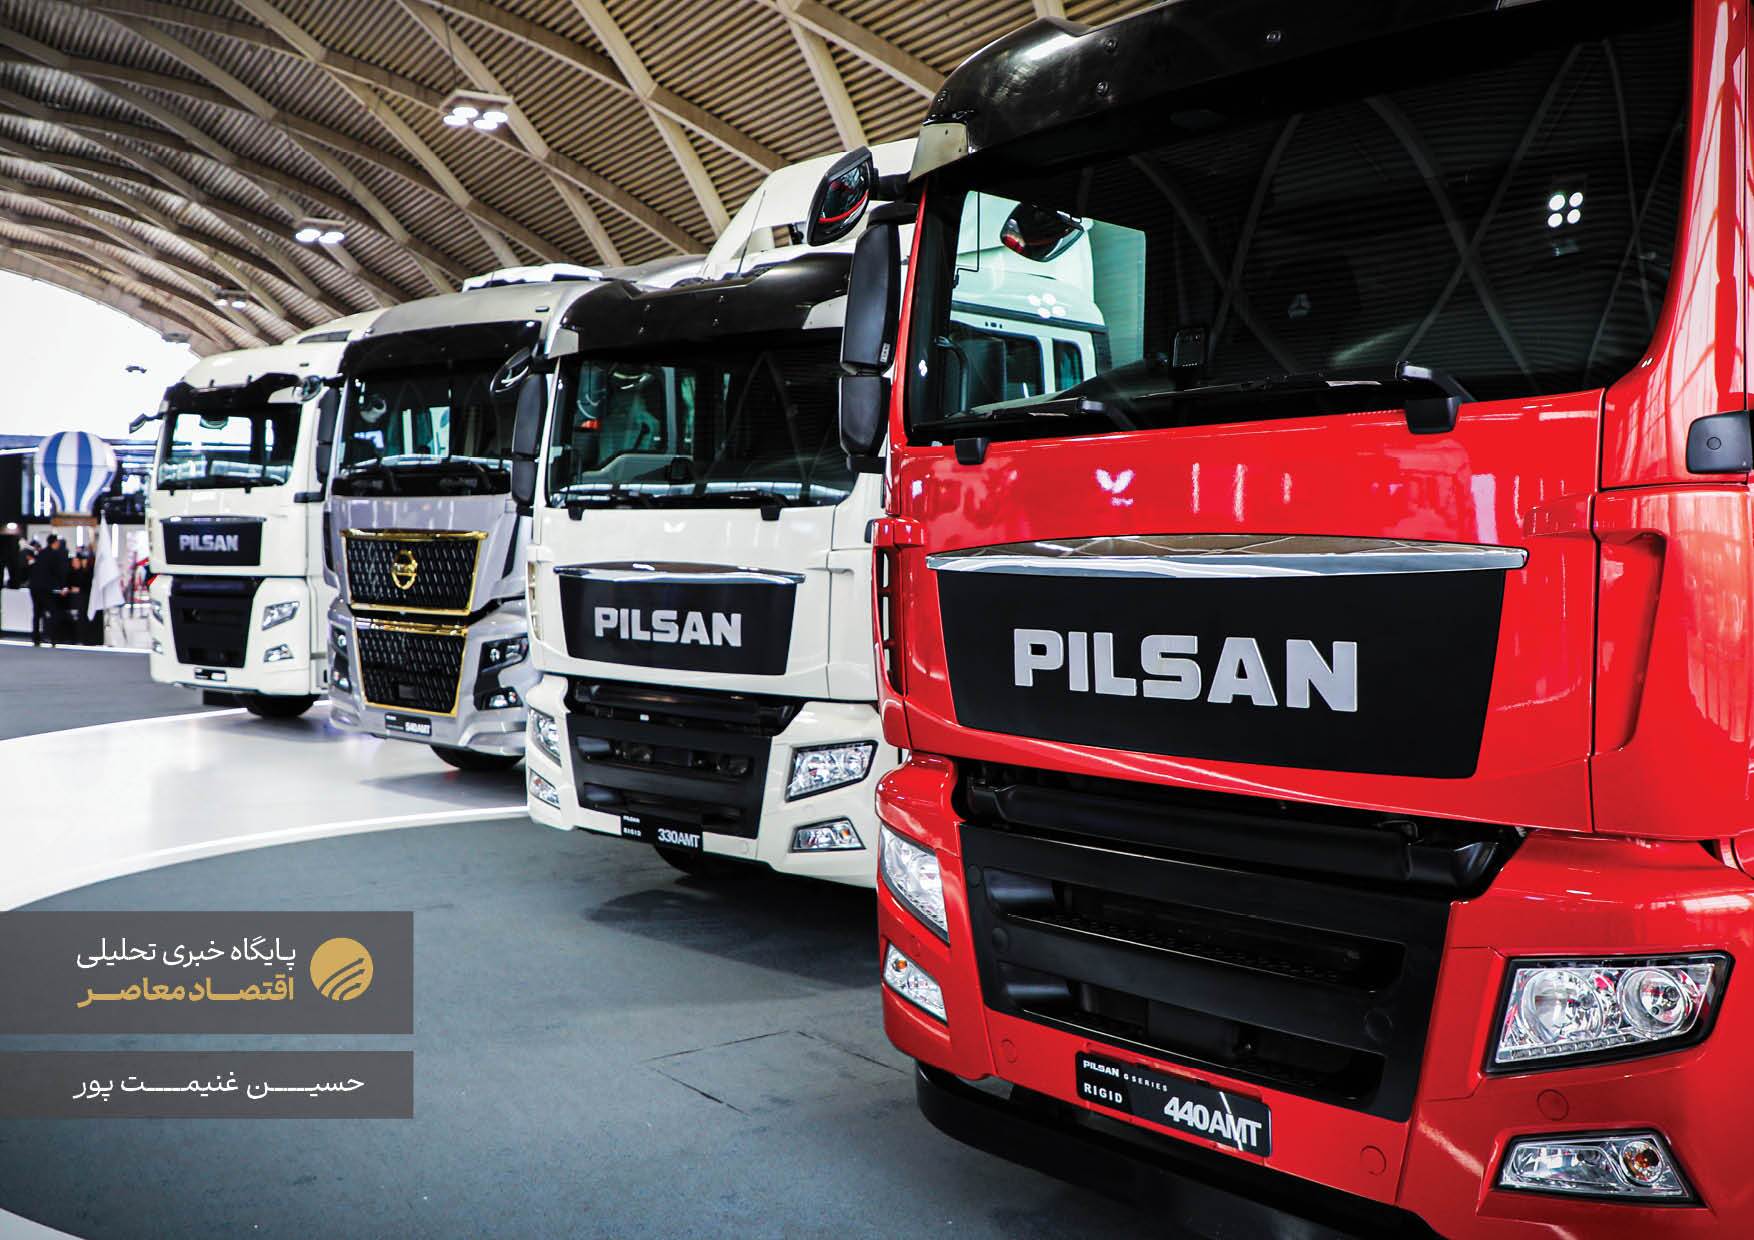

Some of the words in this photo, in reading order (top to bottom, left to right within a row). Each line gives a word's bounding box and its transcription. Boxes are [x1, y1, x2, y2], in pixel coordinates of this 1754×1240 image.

[179, 534, 239, 552] PILSAN
[594, 606, 742, 647] PILSAN
[1014, 628, 1358, 713] PILSAN
[657, 828, 700, 848] 330AMT
[1083, 1060, 1119, 1078] PILSAN
[1131, 1075, 1168, 1092] SERIES
[1083, 1082, 1123, 1104] RIGID
[1164, 1096, 1261, 1147] 440AMT
